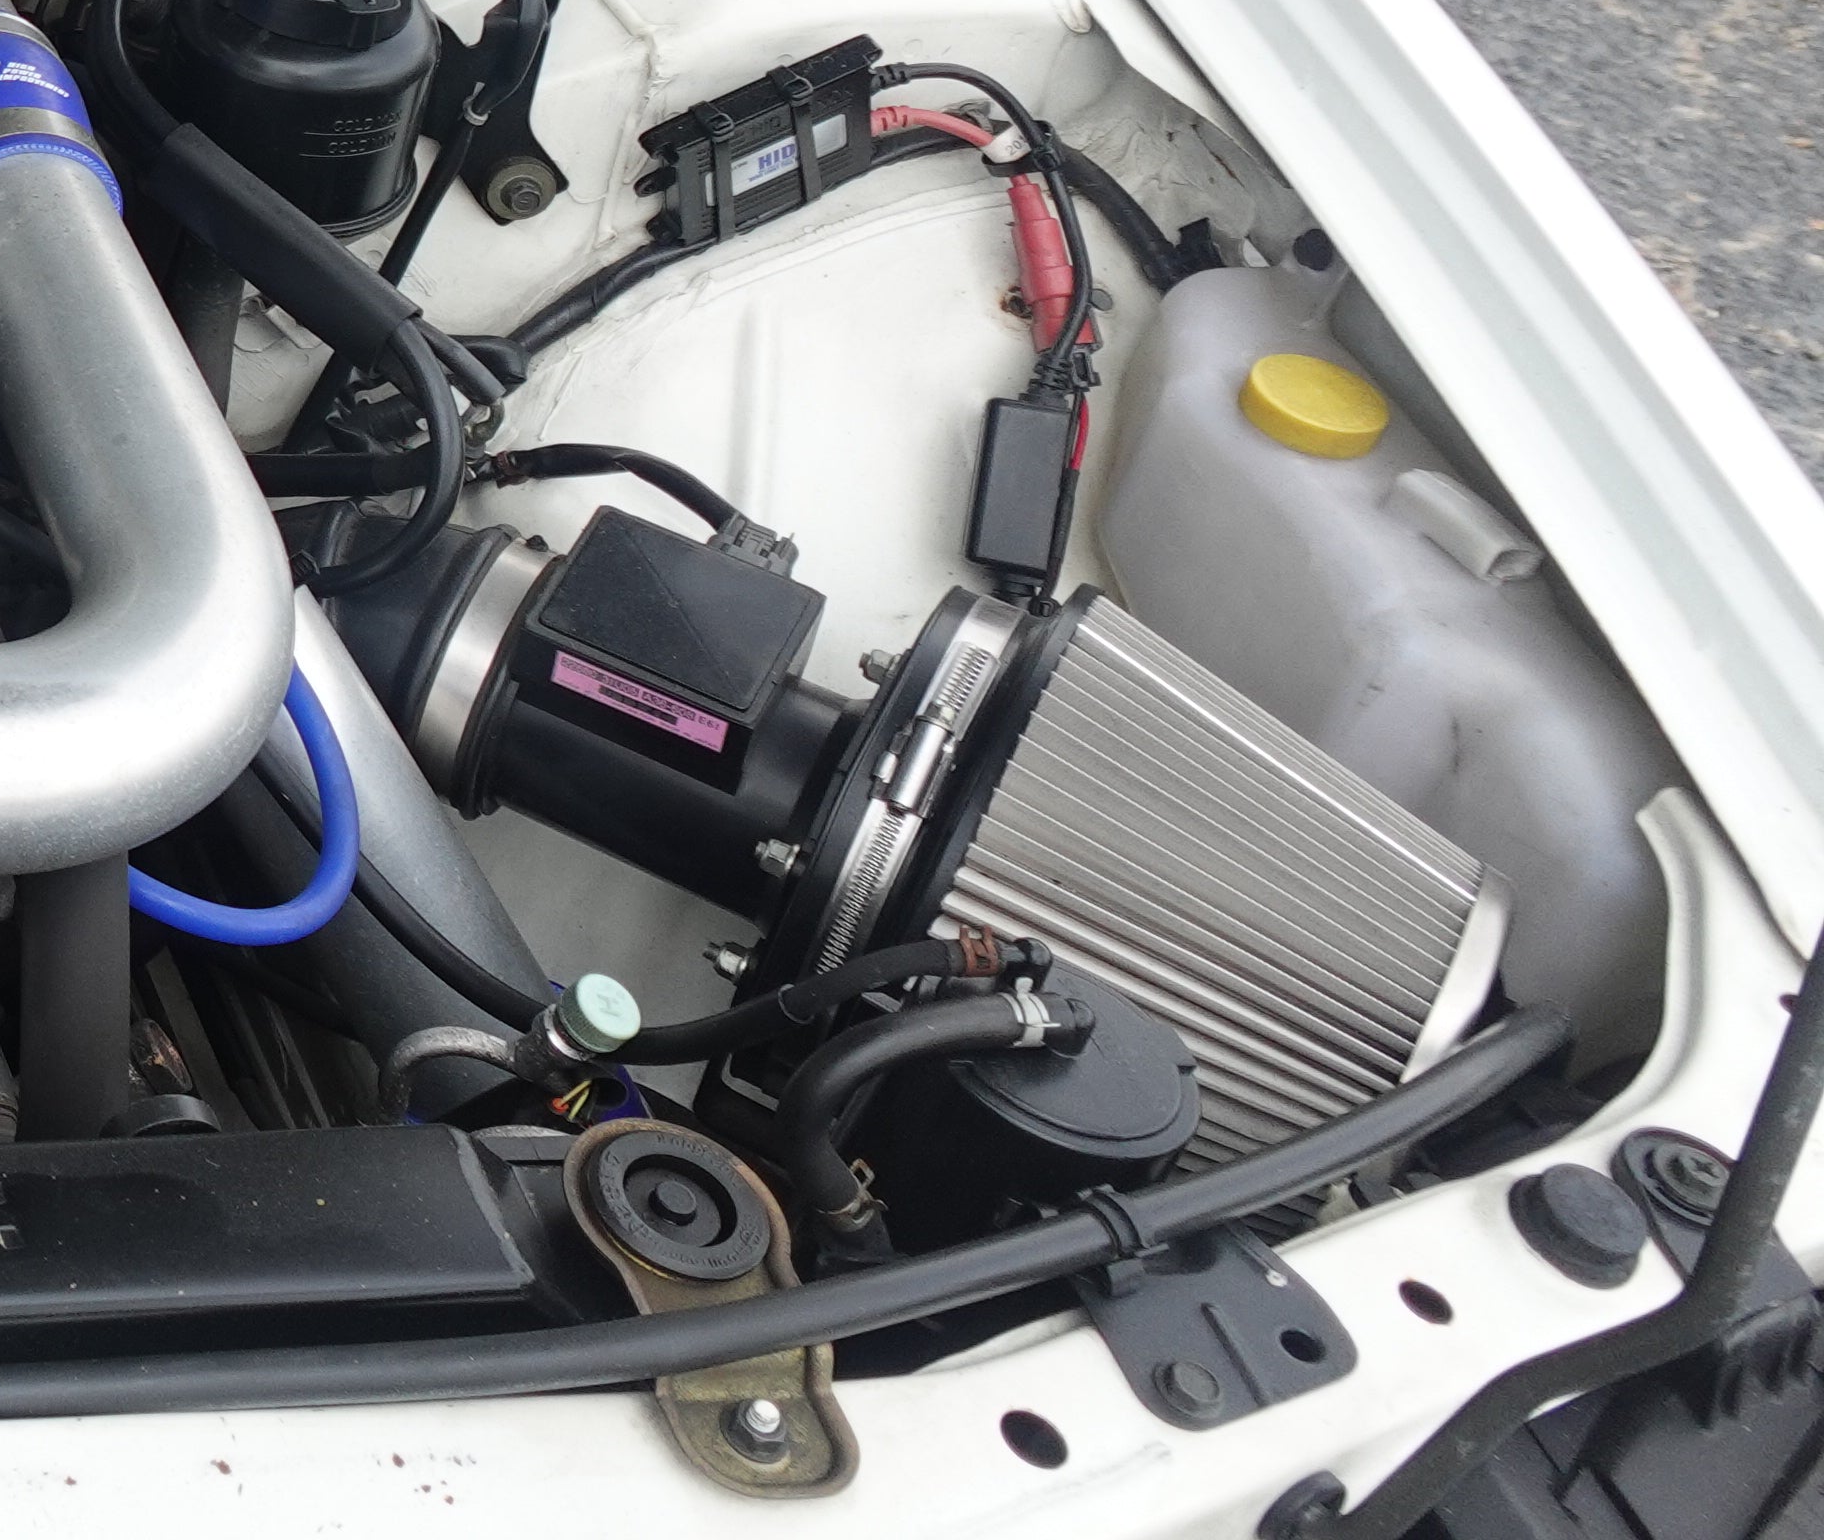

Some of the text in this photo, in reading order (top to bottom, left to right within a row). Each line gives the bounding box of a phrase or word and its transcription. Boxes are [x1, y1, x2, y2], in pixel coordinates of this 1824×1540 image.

[7, 61, 37, 72] HIGH
[2, 68, 42, 79] POWER
[758, 143, 796, 171] HID
